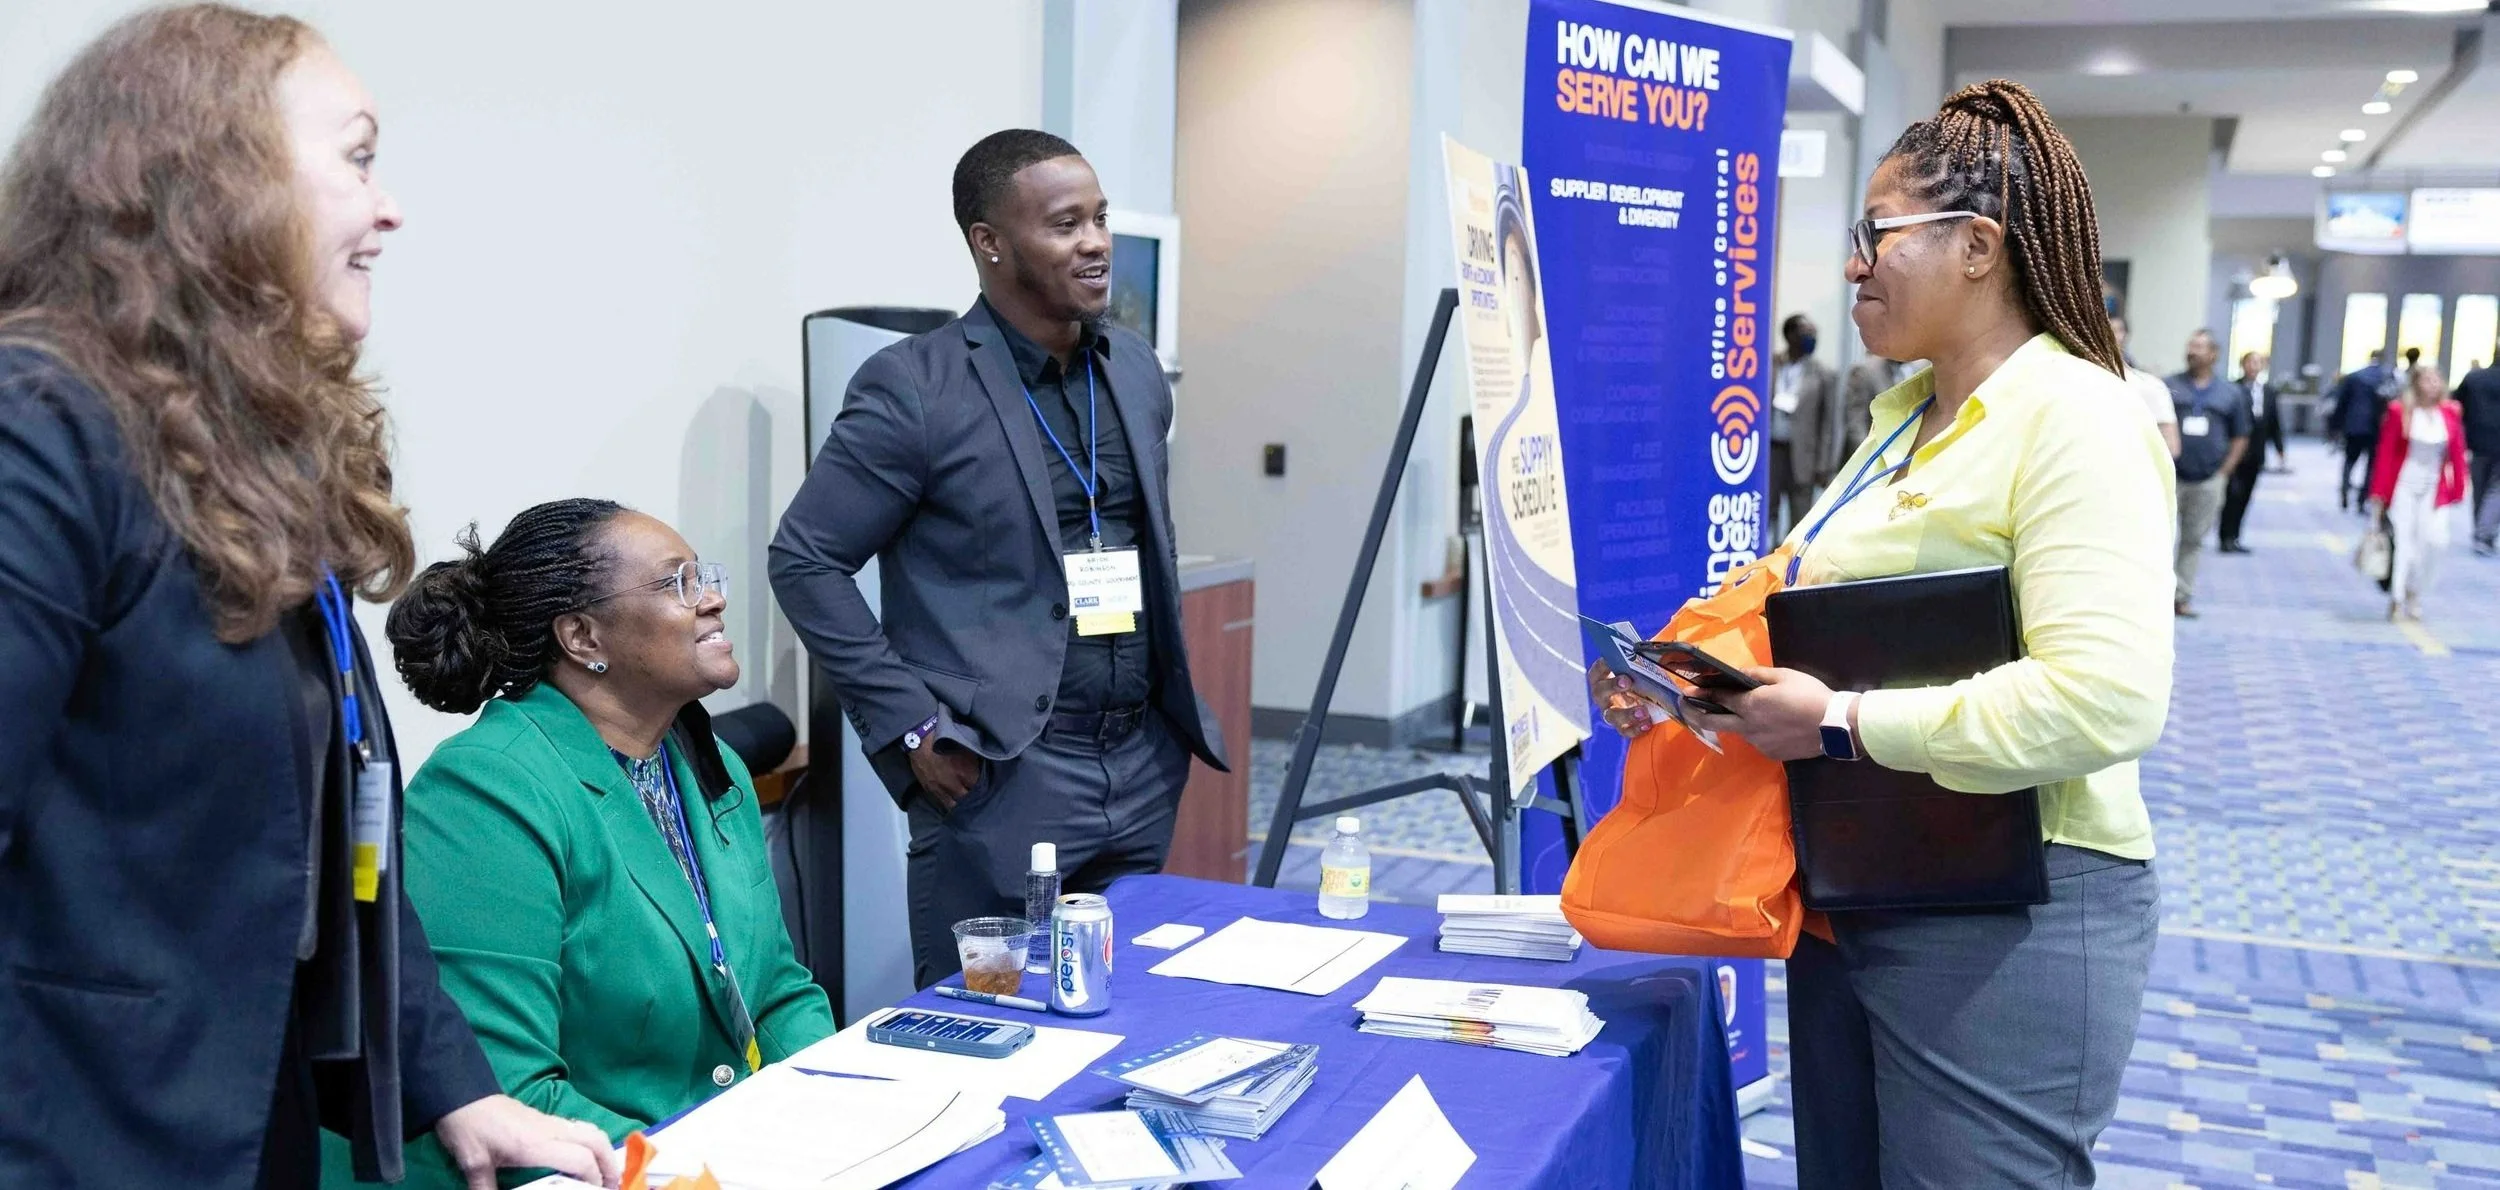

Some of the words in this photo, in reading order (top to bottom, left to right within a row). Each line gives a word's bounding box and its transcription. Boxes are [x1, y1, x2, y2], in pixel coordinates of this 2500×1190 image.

[1557, 20, 1621, 73] HOW
[1623, 34, 1677, 83] CAN
[1680, 44, 1720, 91] WE
[1556, 68, 1639, 122] SERVE
[1643, 82, 1709, 132] YOU?
[1550, 177, 1608, 201] SUPPLIER
[1609, 184, 1685, 209] DEVELOPMENT
[1618, 206, 1628, 225] &
[1628, 207, 1680, 229] DIVERSITY
[1714, 148, 1729, 253] Central
[1713, 258, 1728, 286] of
[1726, 152, 1760, 380] Services
[1711, 297, 1727, 379] Office
[1520, 434, 1553, 475] SUPPLY
[1512, 474, 1556, 520] SCHEDULE
[1699, 493, 1730, 598] ince
[1076, 597, 1099, 605] CLARK
[1059, 931, 1078, 992] pepsi
